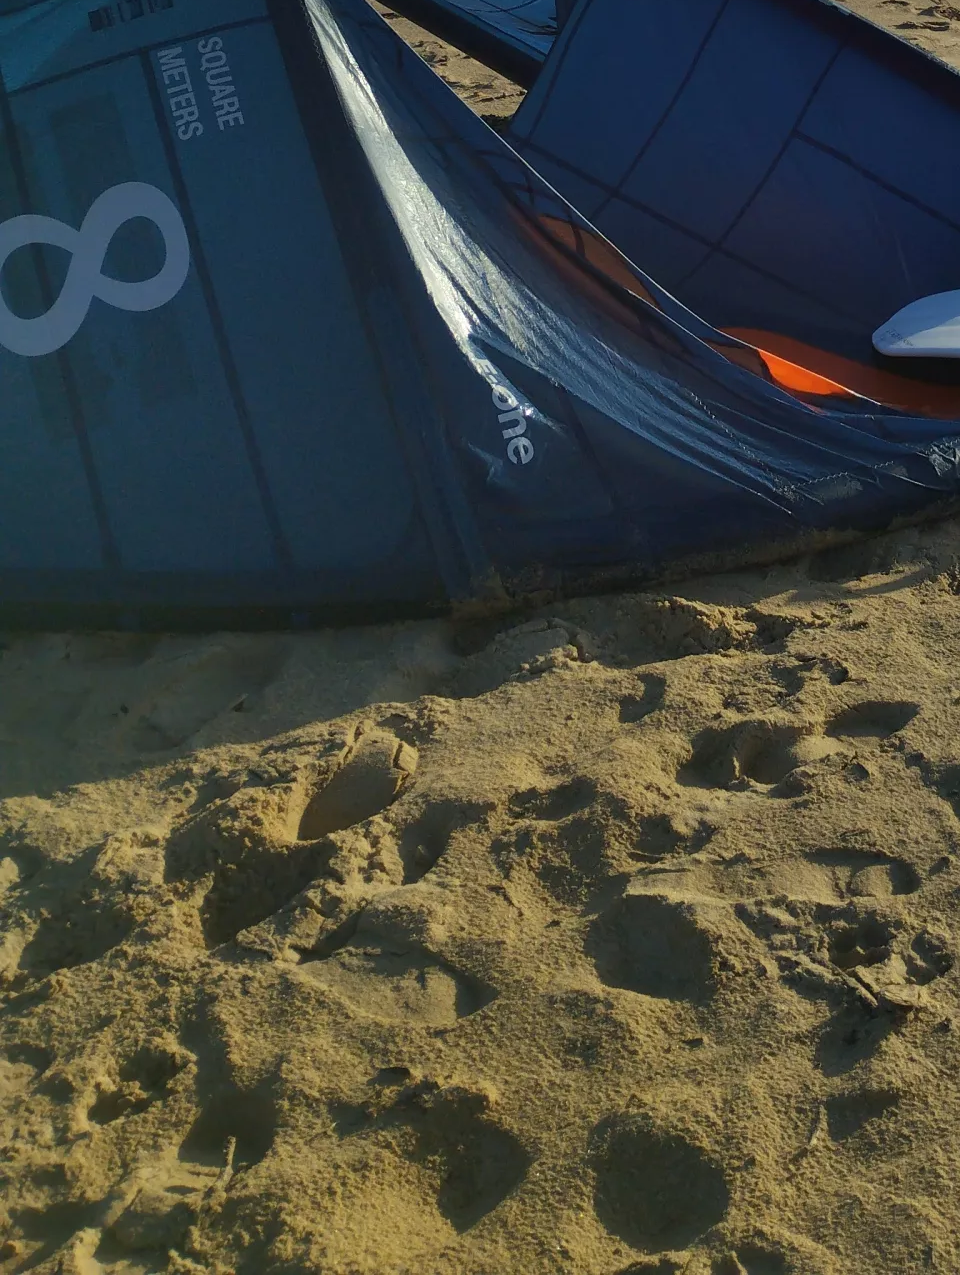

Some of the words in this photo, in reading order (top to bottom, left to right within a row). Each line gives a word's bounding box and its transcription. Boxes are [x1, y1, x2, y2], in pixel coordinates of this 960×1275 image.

[157, 46, 204, 141] METERS
[197, 36, 245, 131] SQUARE
[0, 181, 190, 357] 8
